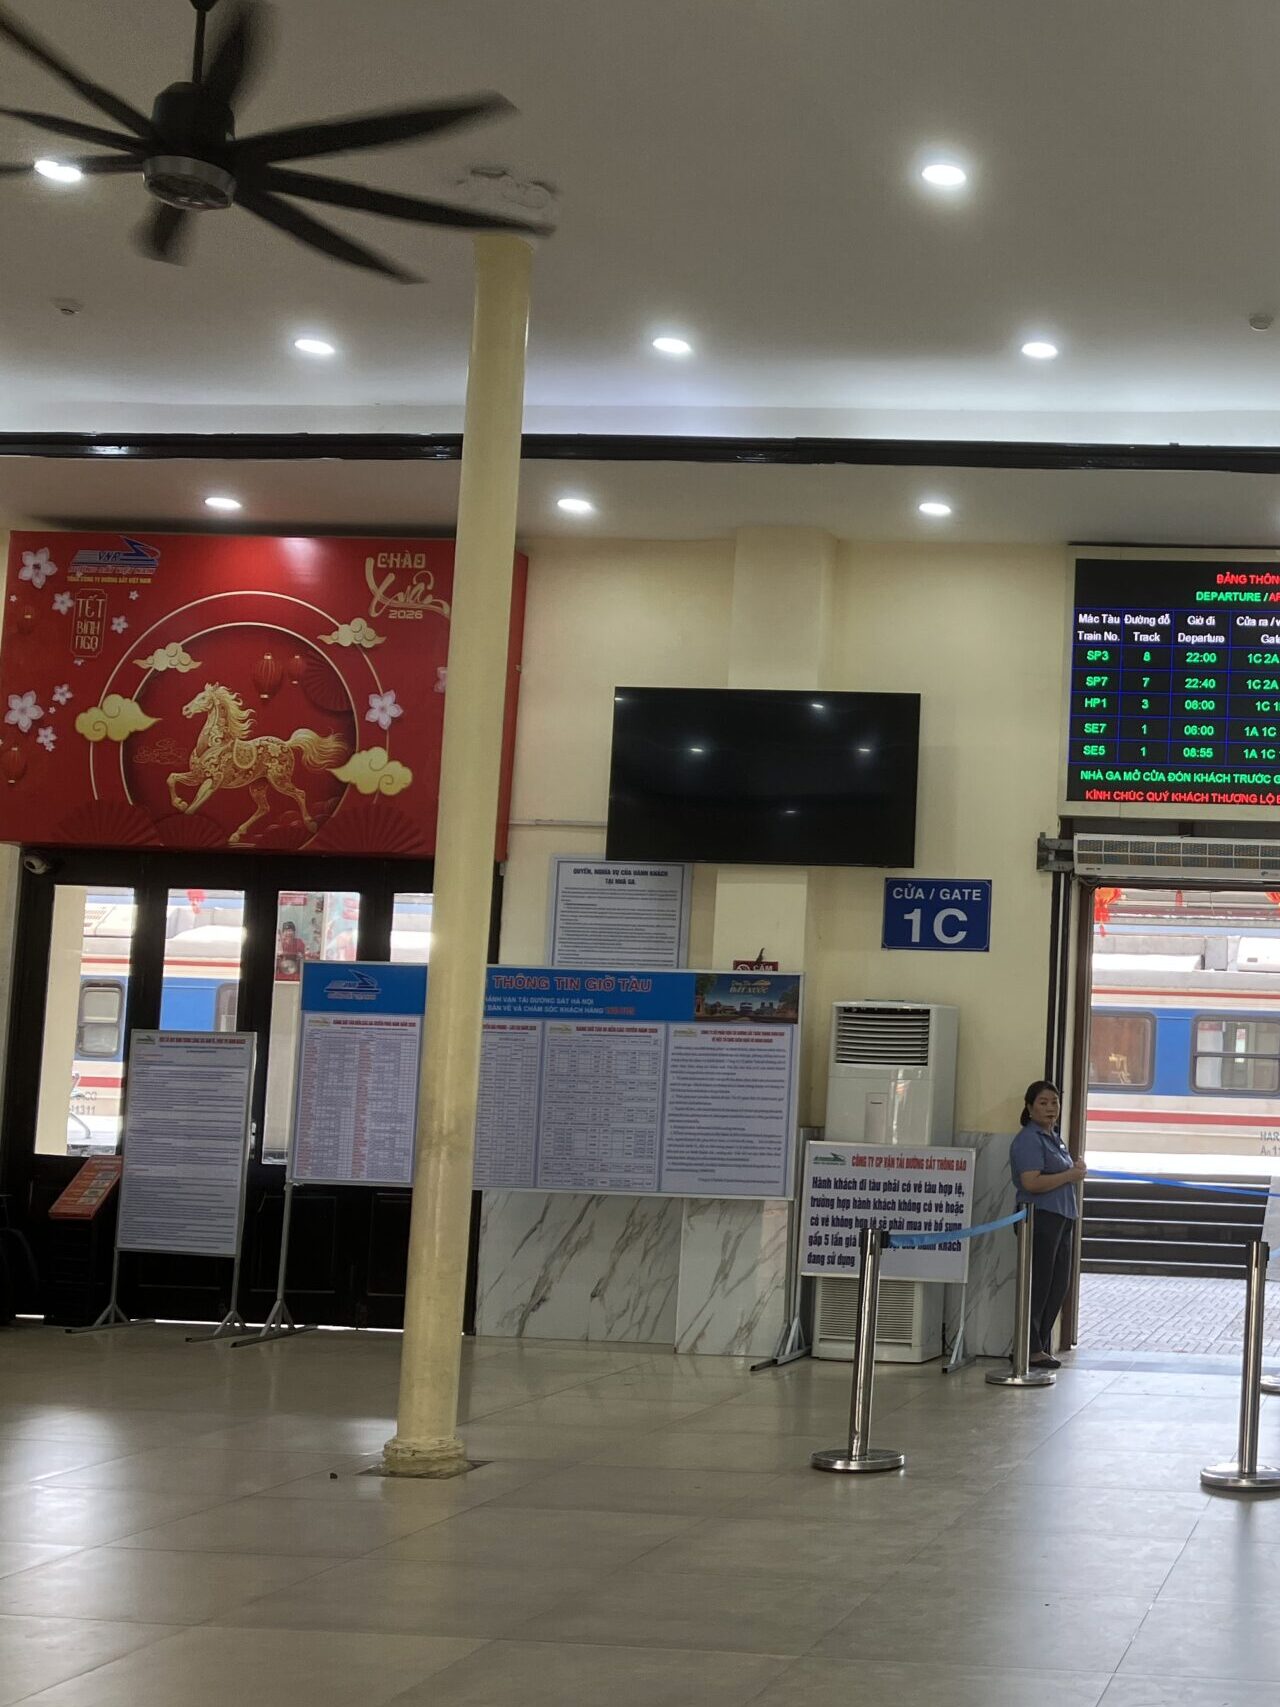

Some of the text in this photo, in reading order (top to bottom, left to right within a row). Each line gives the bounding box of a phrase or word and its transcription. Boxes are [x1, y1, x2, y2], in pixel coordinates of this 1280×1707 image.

[1216, 572, 1247, 585] BẢNG
[1196, 592, 1261, 602] DEPARTURE
[77, 594, 105, 618] TẾT
[389, 610, 423, 619] 2026
[1078, 614, 1120, 624] Mác Tàu
[1124, 614, 1155, 627] Đường
[1187, 615, 1215, 625] Giờ đi
[1237, 616, 1256, 627] Cửa
[1259, 618, 1267, 627] ra
[1077, 631, 1120, 642] Train No.
[1133, 633, 1160, 642] Track
[1178, 633, 1225, 644] Departure
[1087, 651, 1109, 661] SP3
[1143, 652, 1151, 662] 8
[1186, 653, 1216, 663] 22:00
[1086, 677, 1108, 687] SP7
[1142, 678, 1150, 687] 7
[1185, 679, 1216, 689] 22:40
[1084, 698, 1107, 708] HP1
[1142, 700, 1149, 709] 3
[1084, 724, 1106, 734] SE7
[1141, 725, 1147, 734] 1
[1083, 746, 1105, 756] SE5
[1140, 747, 1146, 757] 1
[1183, 747, 1213, 758] 08:55
[1081, 769, 1104, 781] NHÀ
[1106, 771, 1121, 781] GA
[1124, 769, 1141, 782] MỞ
[1143, 769, 1166, 782] CỬA
[1168, 771, 1192, 782] ĐÓN
[1194, 772, 1230, 784] KHÁCH
[1233, 773, 1272, 784] TRƯỚC
[1113, 791, 1144, 801] CHÚC
[1147, 790, 1169, 802] QUÝ
[1172, 792, 1209, 803] KHÁCH
[892, 884, 982, 900] CỬA GATE
[904, 908, 968, 944] 1C
[493, 973, 652, 992] THÔNG TIN GIỜ TÀU
[812, 1177, 832, 1189] Hành
[834, 1178, 857, 1190] khách
[869, 1179, 881, 1191] tàu
[902, 1181, 911, 1192] có
[925, 1181, 936, 1194] tàu
[853, 1199, 871, 1210] hành
[873, 1199, 896, 1211] khách
[898, 1200, 921, 1214] không
[923, 1202, 932, 1213] có
[831, 1215, 853, 1229] không
[906, 1220, 922, 1231] mua
[824, 1234, 829, 1245] 5
[807, 1253, 825, 1266] đang
